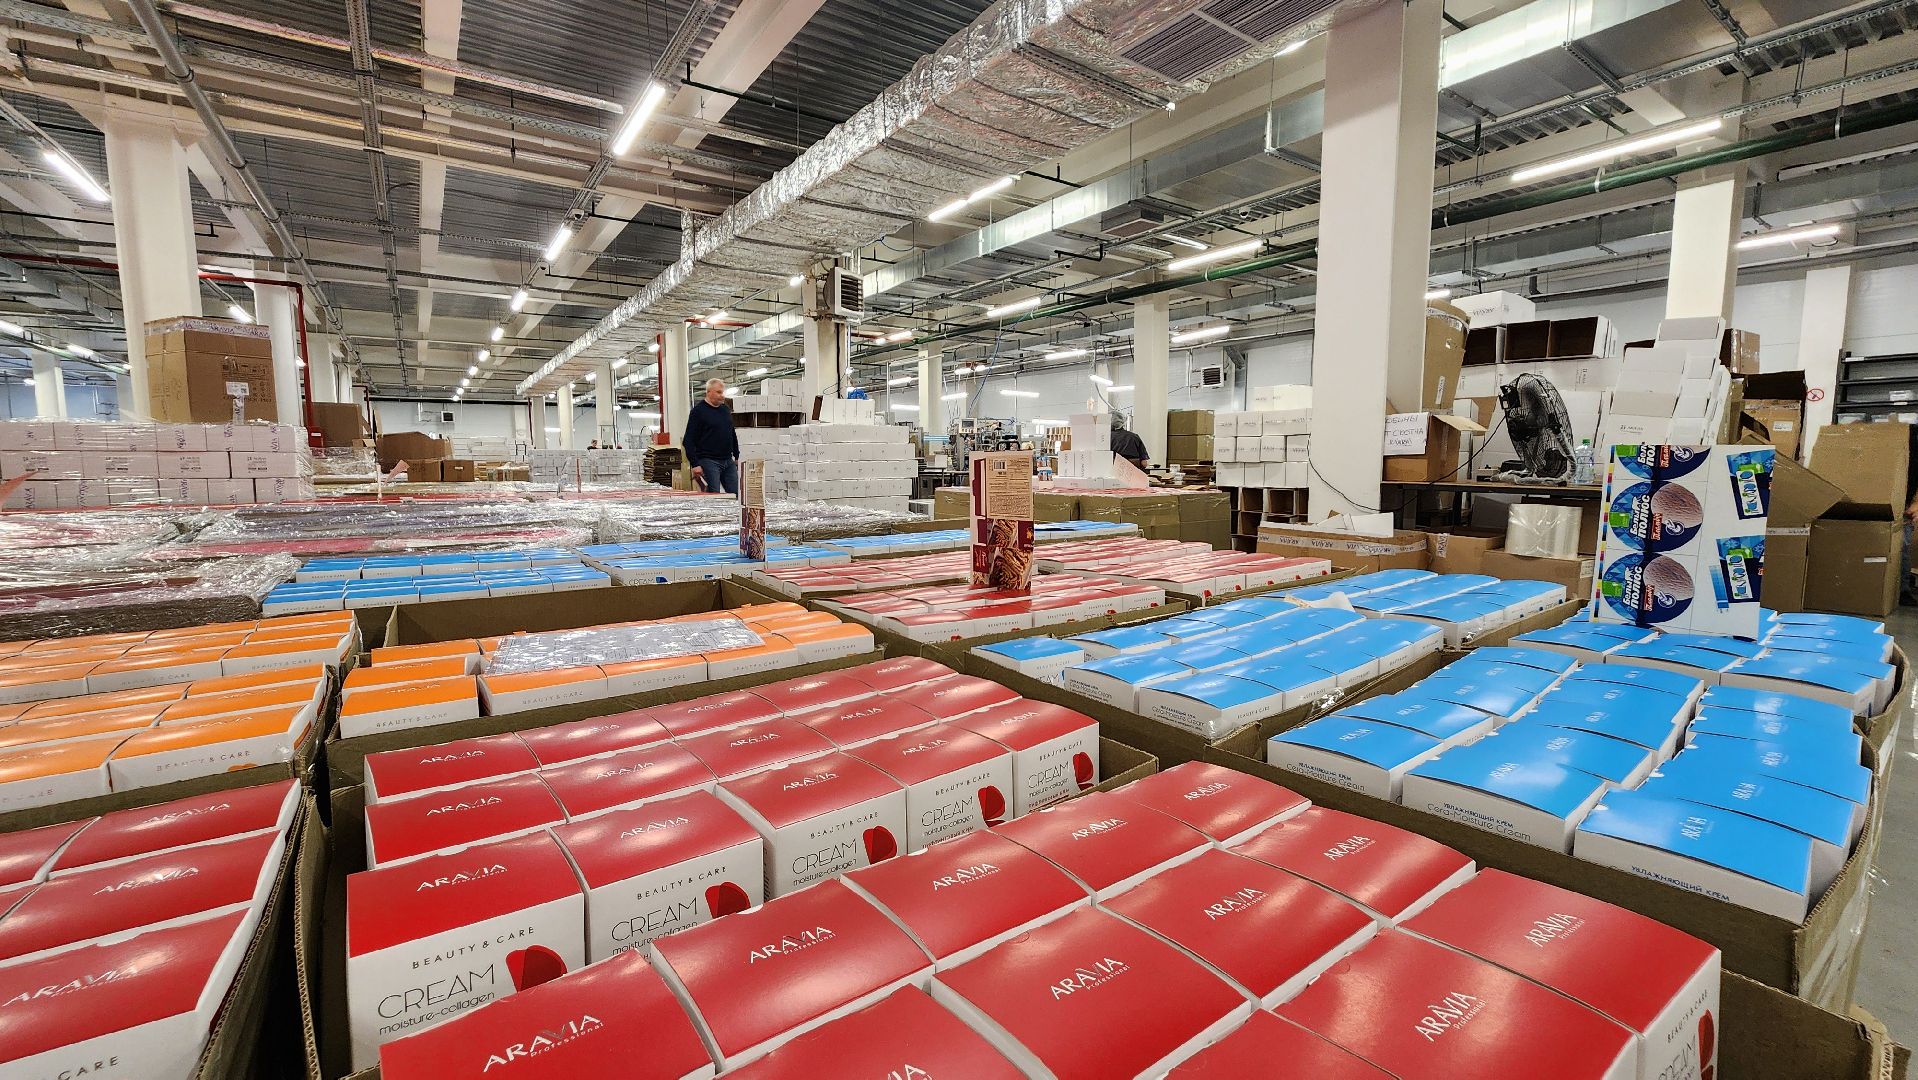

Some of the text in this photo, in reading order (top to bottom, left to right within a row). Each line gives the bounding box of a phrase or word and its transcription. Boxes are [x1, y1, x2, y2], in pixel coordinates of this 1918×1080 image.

[1028, 760, 1070, 789] CREAM
[810, 824, 846, 839] BEAUTY
[857, 811, 878, 823] CARE
[921, 796, 974, 828] CREAM
[1071, 816, 1125, 840] ARAVIA
[1427, 803, 1531, 842] Cera-Moisture Cream
[792, 838, 857, 875] CREAM
[1324, 834, 1371, 861] ARAVIA
[637, 877, 684, 901] BEAUTY
[698, 865, 727, 881] CARE
[932, 862, 998, 891] ARAVIA
[1631, 864, 1730, 902] УВЛАЖНЯЮЩИЙ КРЕМ
[611, 896, 698, 942] CREAM
[1204, 887, 1264, 921] ARAVIA
[411, 943, 476, 970] BEAUTY
[496, 926, 535, 944] CARE
[750, 926, 832, 964] ARAVIA
[1524, 911, 1577, 948] ARAVIA
[377, 963, 496, 1019] CREAM
[1050, 957, 1124, 1000] ARAVIA
[379, 990, 496, 1036] moisture-collagen
[1415, 991, 1477, 1042] ARAVIA
[483, 1014, 601, 1073] ARAVIA
[530, 1022, 605, 1058] Professional
[57, 1056, 120, 1080] CARE
